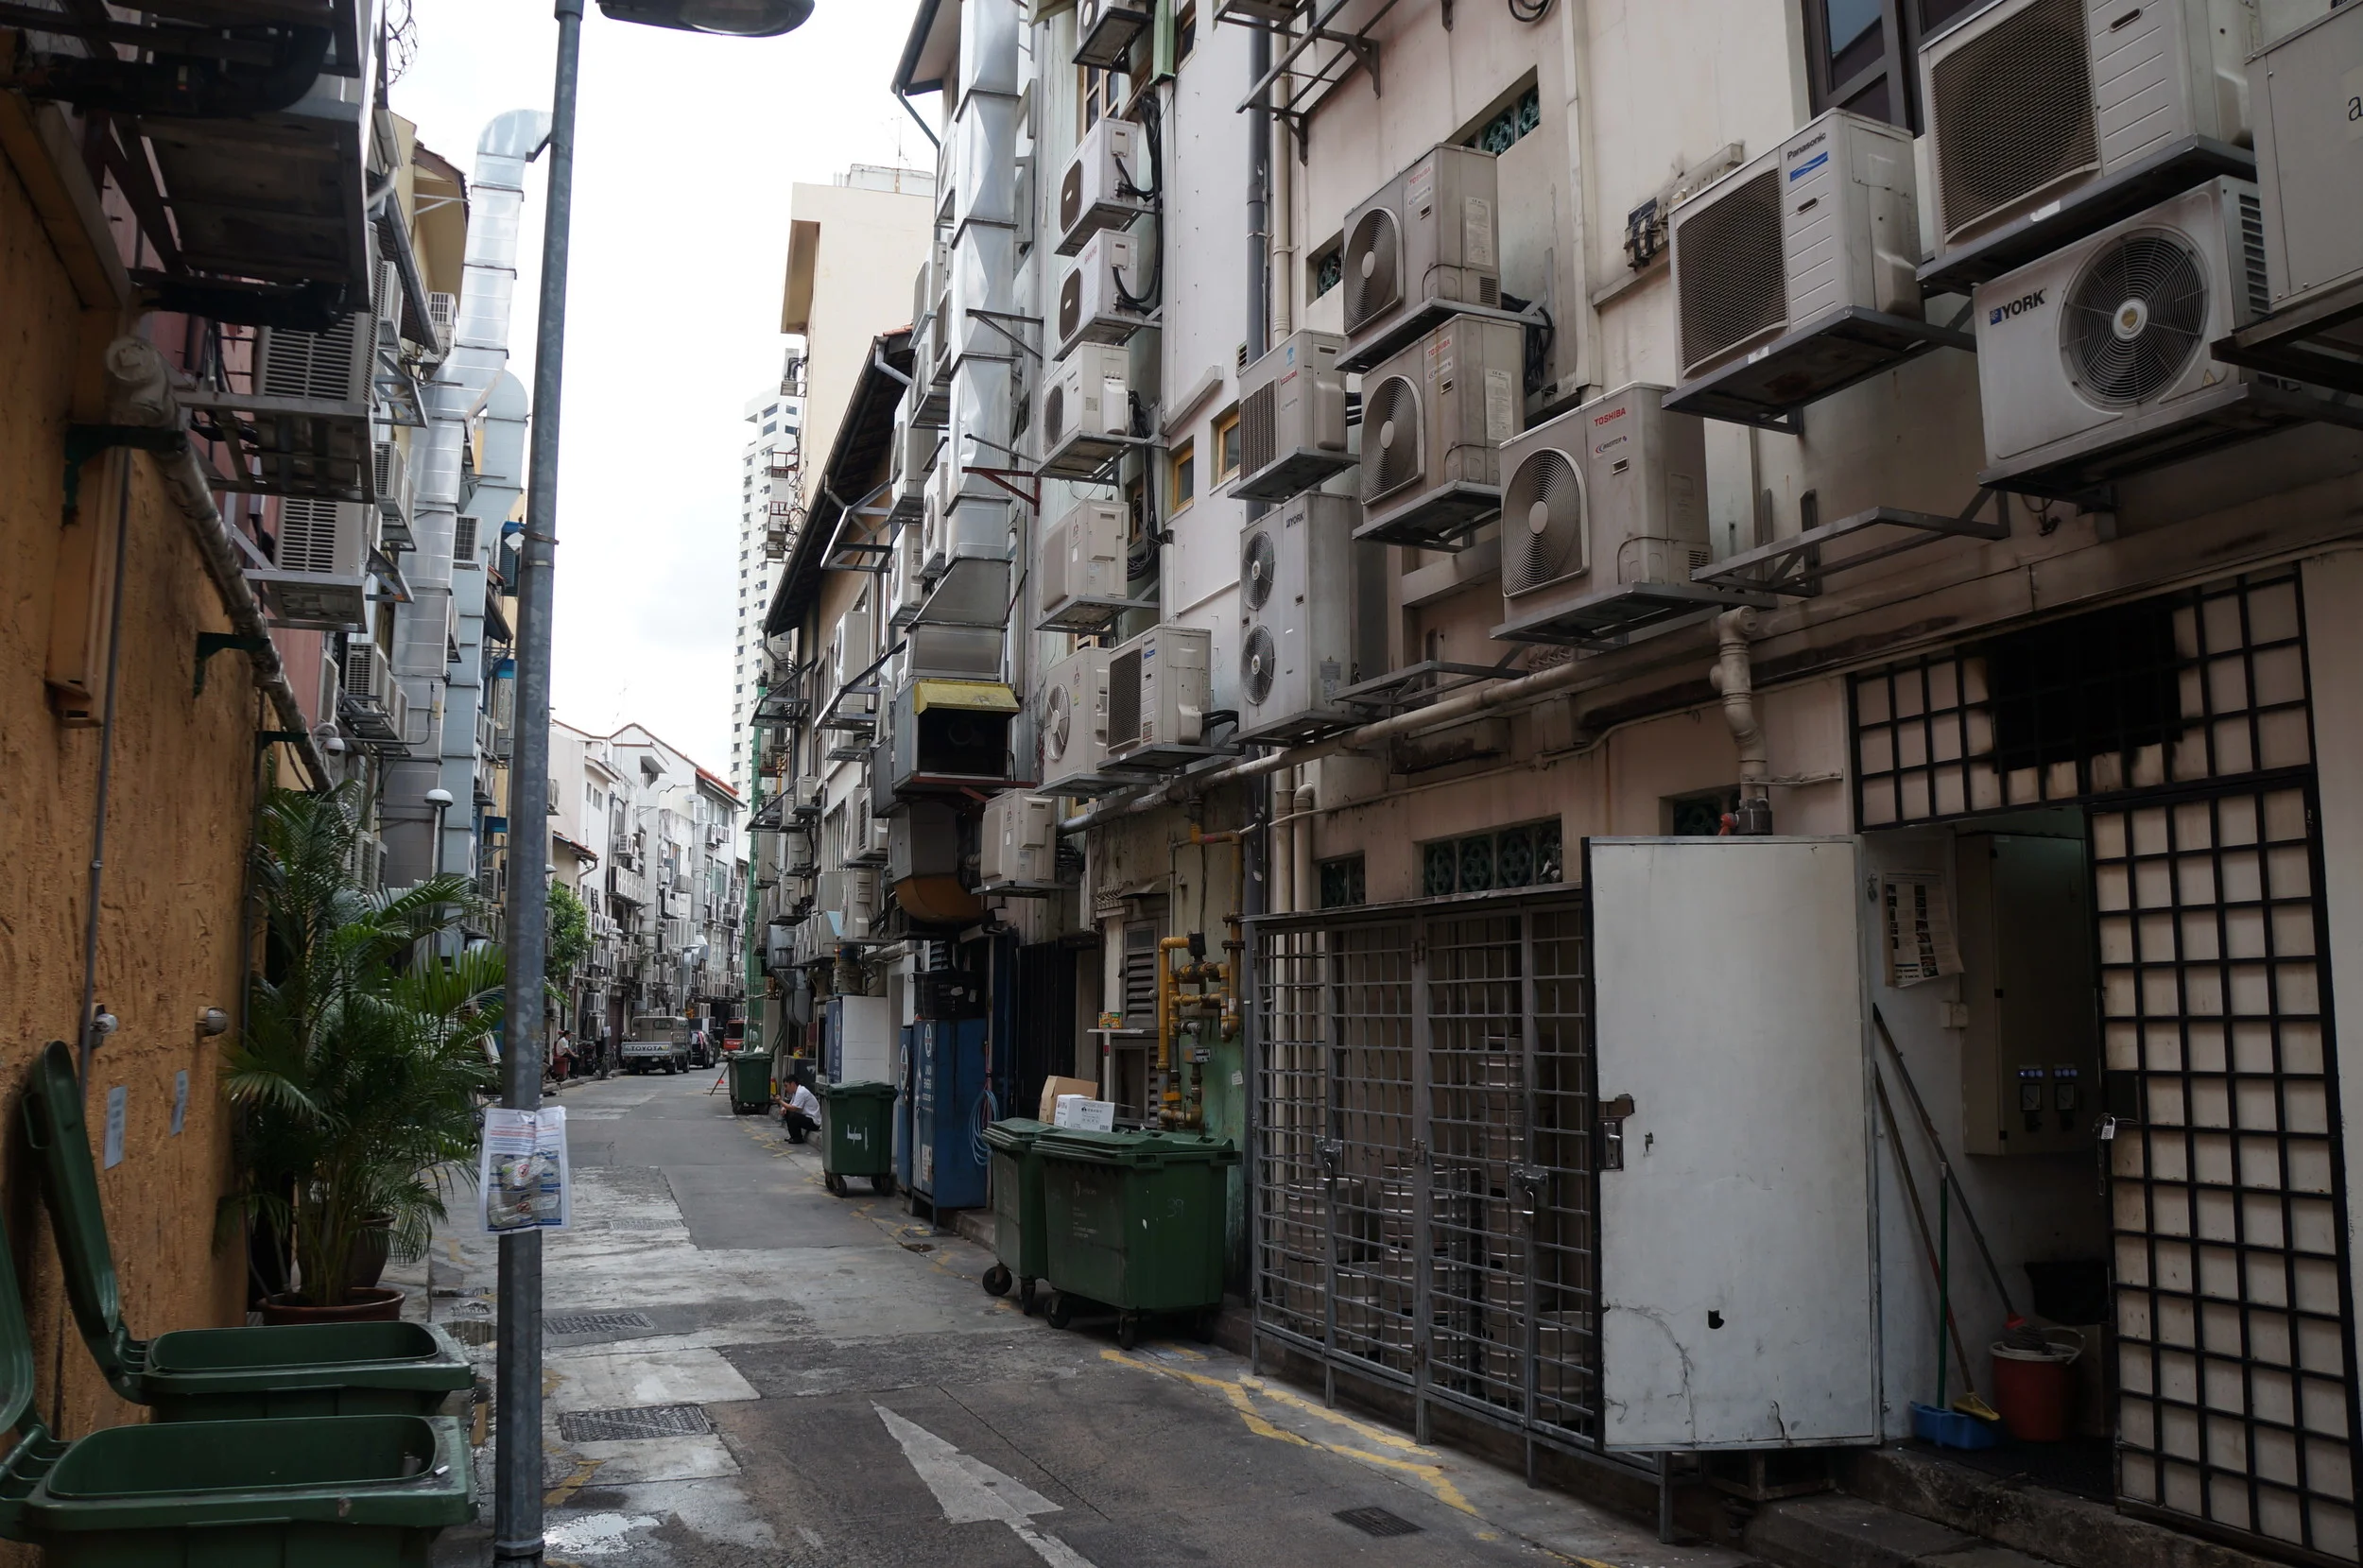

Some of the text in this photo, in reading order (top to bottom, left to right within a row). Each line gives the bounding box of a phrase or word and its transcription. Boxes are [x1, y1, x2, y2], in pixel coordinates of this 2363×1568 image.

[1787, 132, 1826, 161] Panasonic
[2002, 288, 2045, 319] YORK
[1428, 338, 1450, 357] TOSHIBA
[1595, 407, 1626, 426] TOSHIBA
